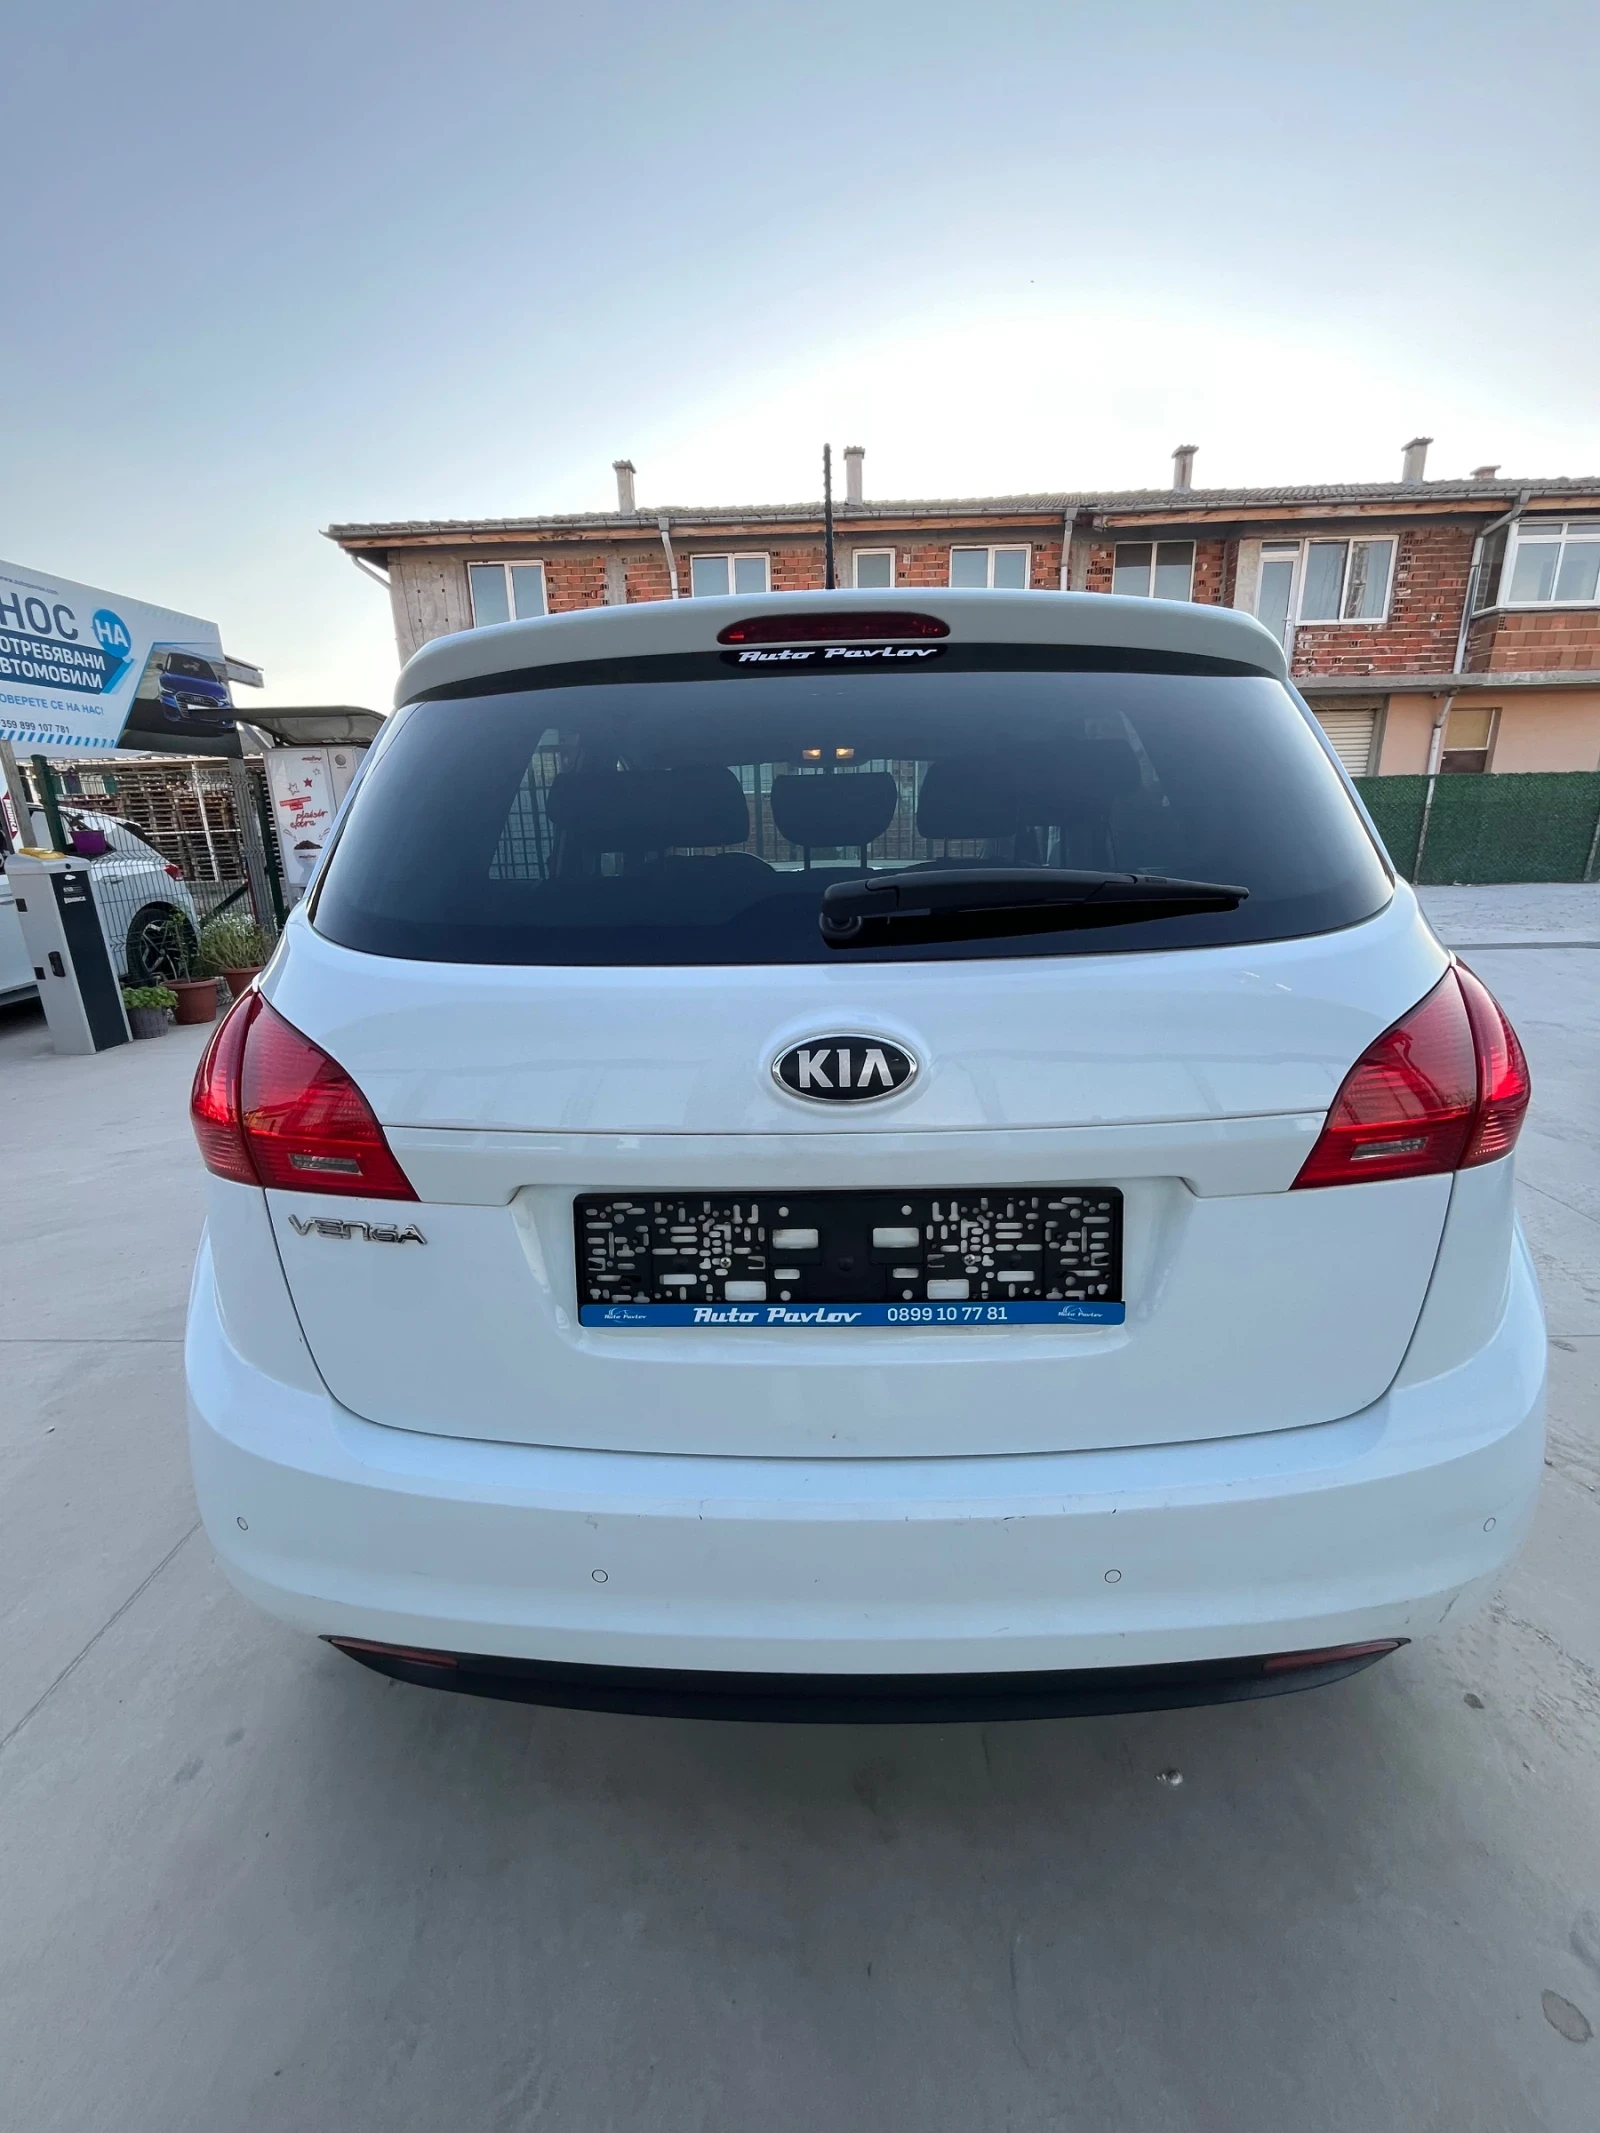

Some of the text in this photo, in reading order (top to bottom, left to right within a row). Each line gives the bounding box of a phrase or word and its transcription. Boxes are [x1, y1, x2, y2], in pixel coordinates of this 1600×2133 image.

[95, 618, 130, 649] НА
[738, 649, 815, 662] Auto
[0, 656, 103, 689] ВТОМОБИЛИ
[50, 700, 65, 711] СЕ
[66, 702, 81, 713] НА
[19, 721, 36, 731] 899
[38, 723, 53, 733] 107
[54, 724, 70, 734] 781
[797, 1049, 894, 1088] KIA
[287, 1213, 427, 1245] VENGA
[693, 1307, 760, 1323] Auto
[887, 1306, 1008, 1322] 0899 10 77 81
